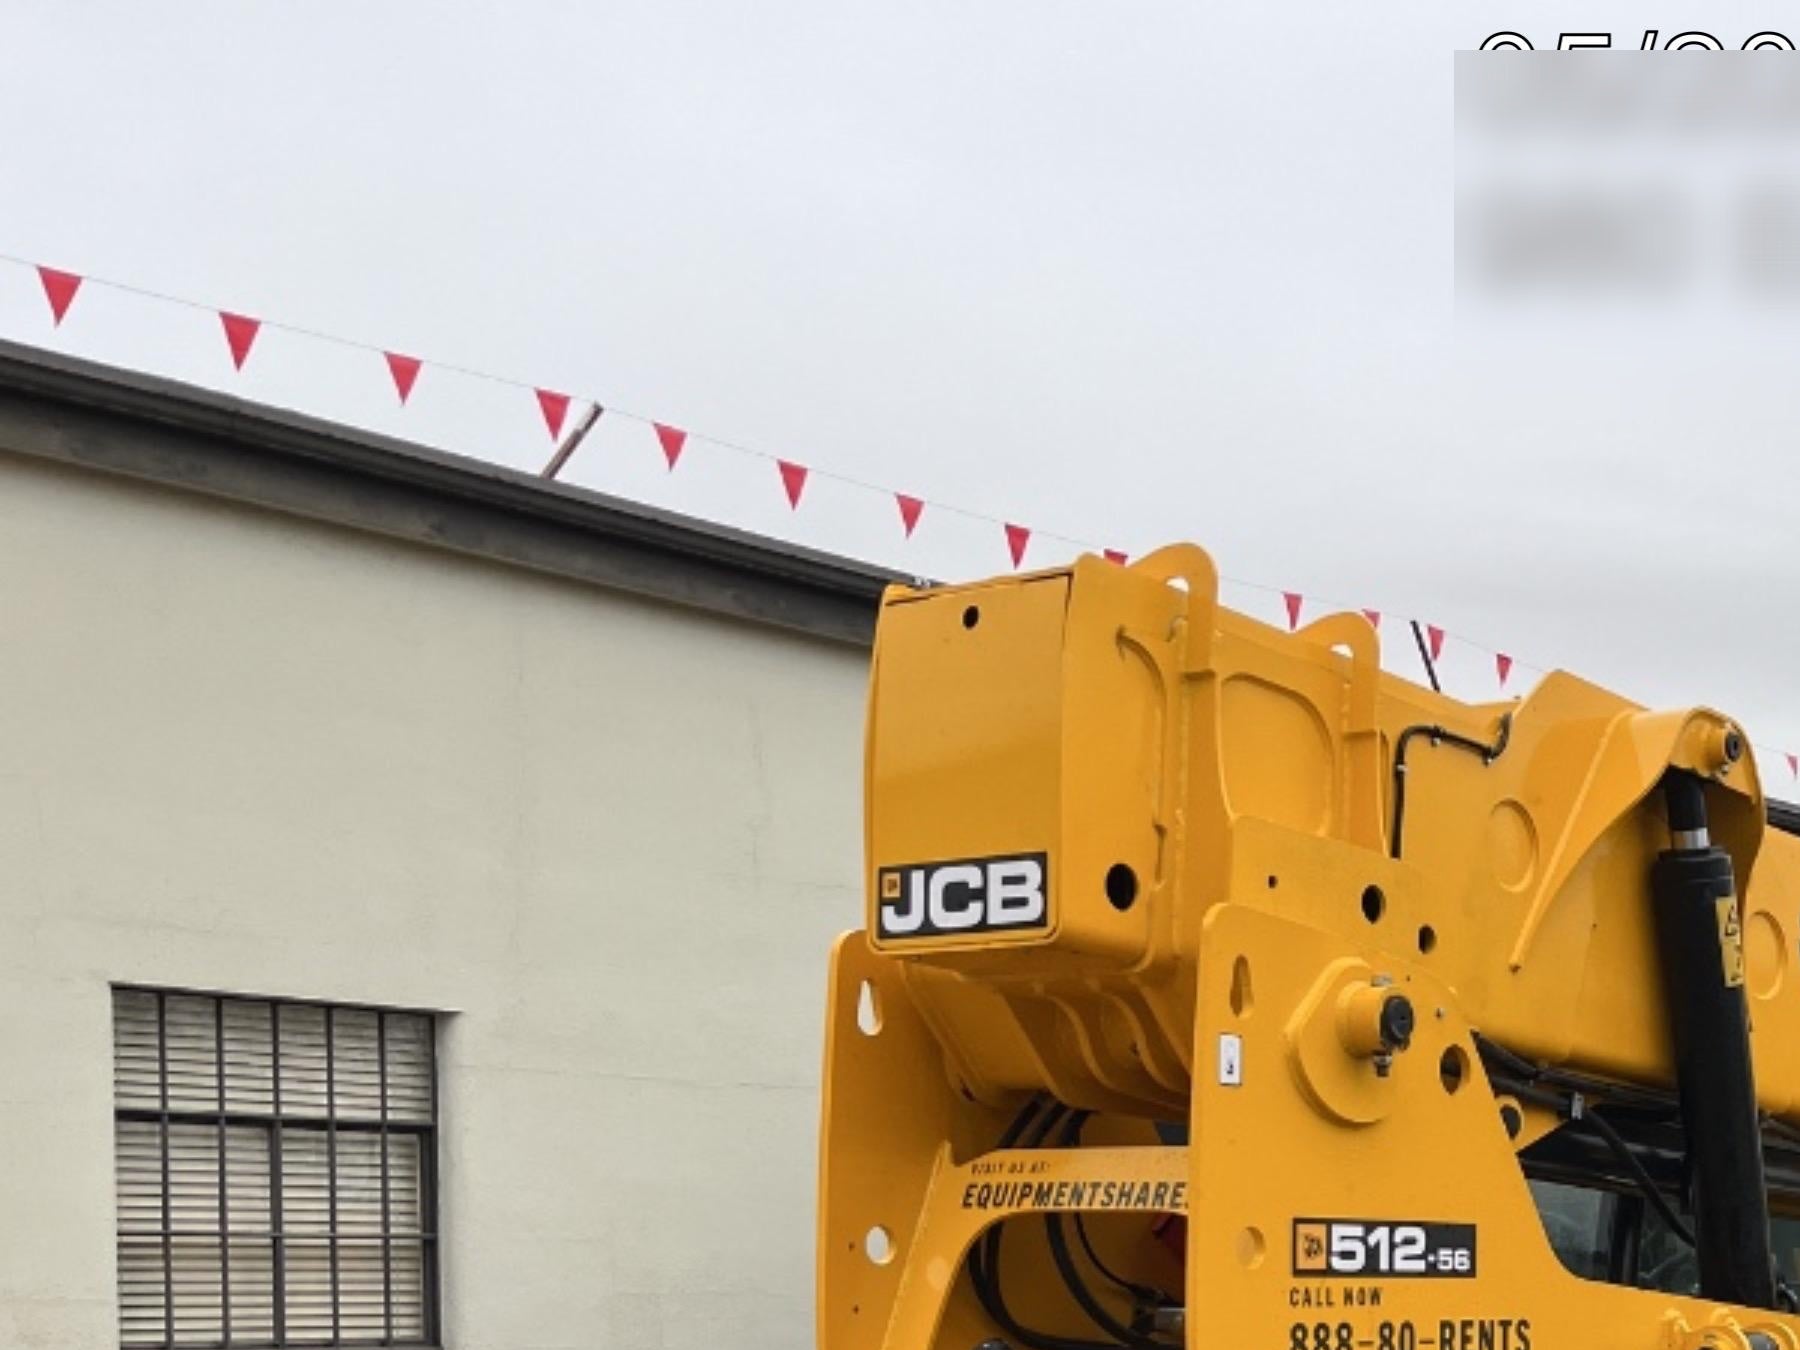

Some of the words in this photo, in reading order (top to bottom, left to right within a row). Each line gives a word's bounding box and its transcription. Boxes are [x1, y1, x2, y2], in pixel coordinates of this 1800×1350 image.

[881, 860, 1044, 933] JCB
[1289, 1287, 1335, 1308] CALL
[1343, 1287, 1382, 1306] NOW
